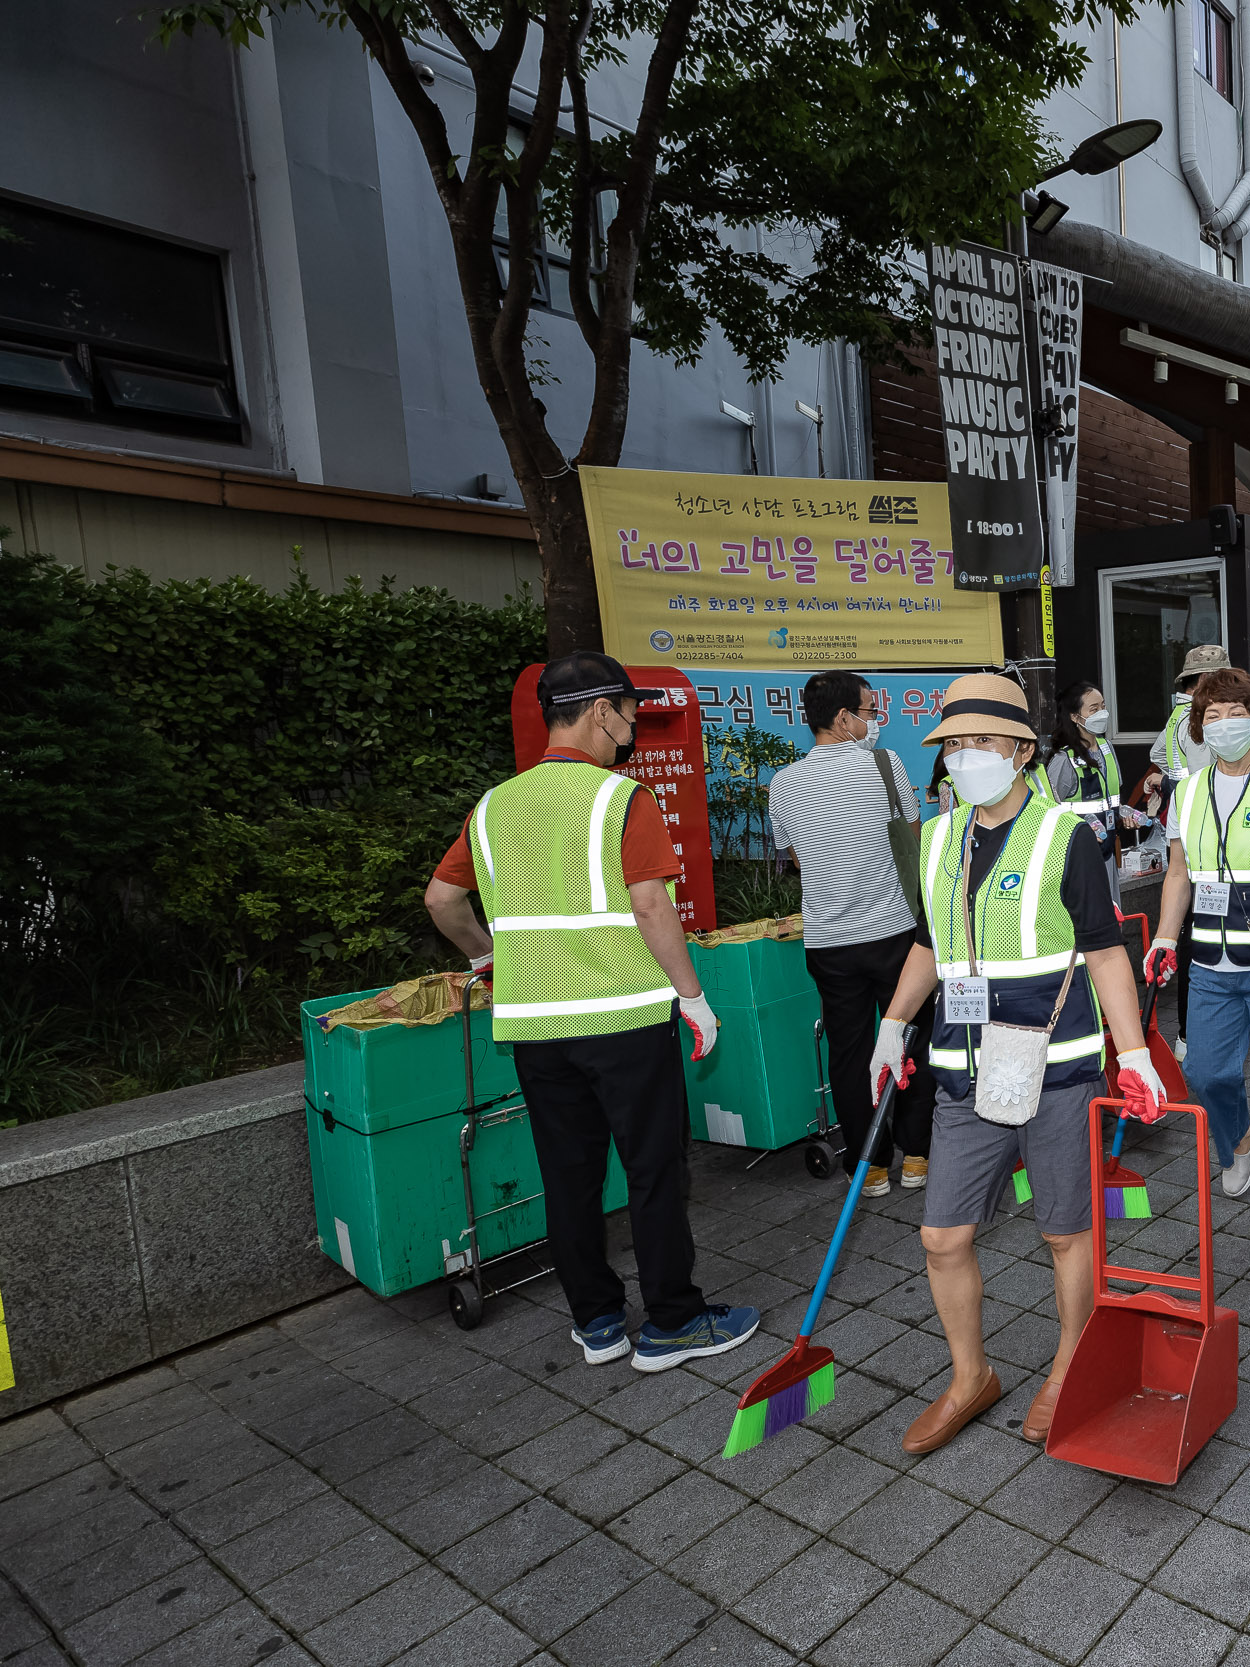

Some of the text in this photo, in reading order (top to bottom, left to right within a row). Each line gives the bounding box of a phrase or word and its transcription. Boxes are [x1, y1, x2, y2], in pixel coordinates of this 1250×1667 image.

[932, 244, 988, 290] APRIL
[991, 258, 1016, 297] TO
[934, 284, 1020, 335] OCTOBER
[1061, 276, 1079, 312] TO
[935, 326, 1021, 382] FRIDAY
[940, 375, 1026, 432] MUSIC
[946, 428, 1029, 481] PARTY
[674, 492, 919, 525] 청소년 상담 프로그램 썰존
[977, 521, 1014, 536] 18:00
[618, 528, 701, 574] 너의
[718, 535, 819, 584] 고민을
[668, 594, 943, 615] 매주 화요일 오후 4시에 여기서 만나!!
[1044, 589, 1054, 646] 금연구역
[675, 652, 744, 661] 02)2285-7404
[676, 633, 745, 643] 서울광진경찰서
[792, 651, 858, 661] 02)2205-2300
[697, 684, 756, 725] 근심
[871, 688, 893, 728] 망
[645, 749, 667, 764] 위기와
